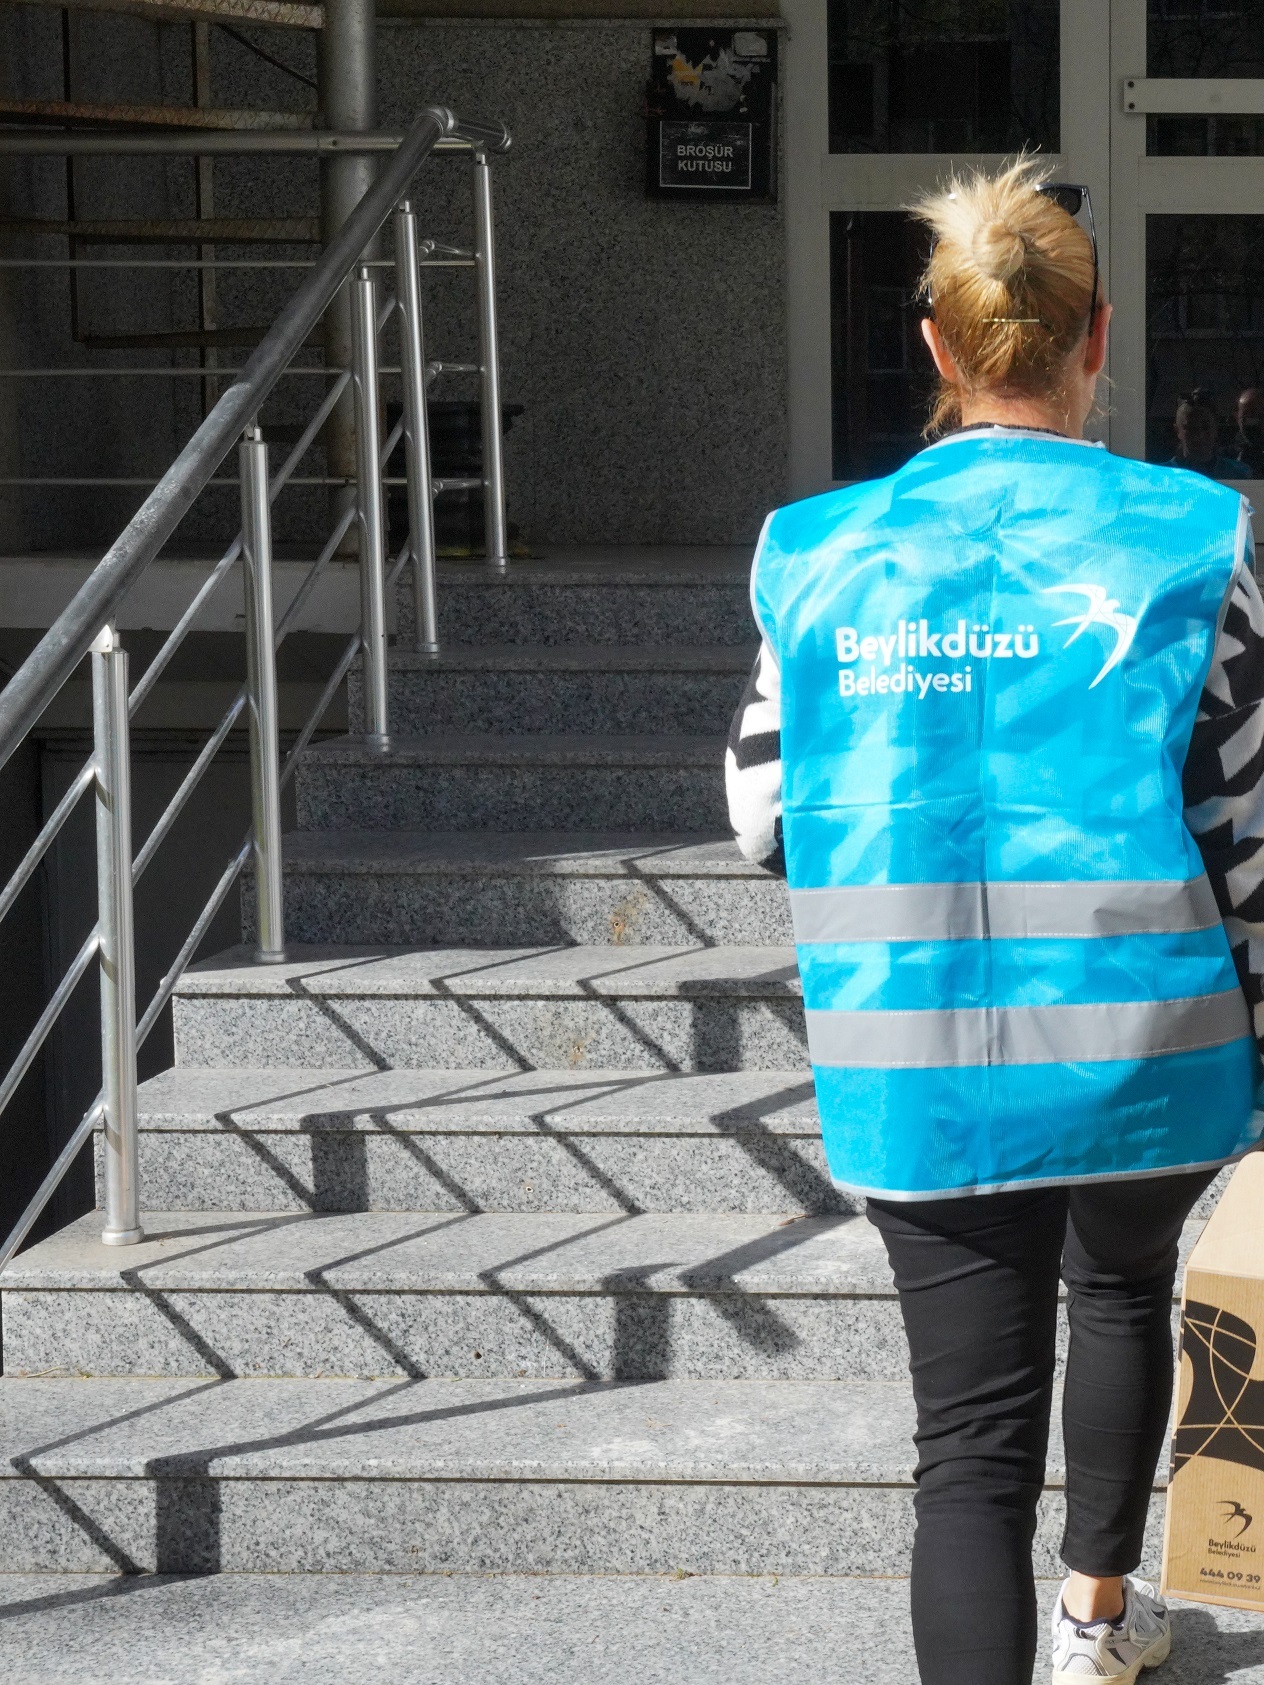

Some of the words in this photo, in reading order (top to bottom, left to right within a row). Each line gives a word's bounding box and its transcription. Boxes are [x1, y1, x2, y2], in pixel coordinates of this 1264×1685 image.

[677, 144, 733, 159] BROŞÜR
[678, 161, 732, 172] KUTUSU
[835, 619, 1039, 666] Beylikdüzü
[838, 665, 972, 700] Belediyesi
[1207, 1547, 1241, 1559] Belediyesi
[1208, 1538, 1257, 1553] Beylikdüzü
[1200, 1567, 1224, 1578] 444
[1227, 1571, 1243, 1581] 09
[1246, 1573, 1261, 1583] 39
